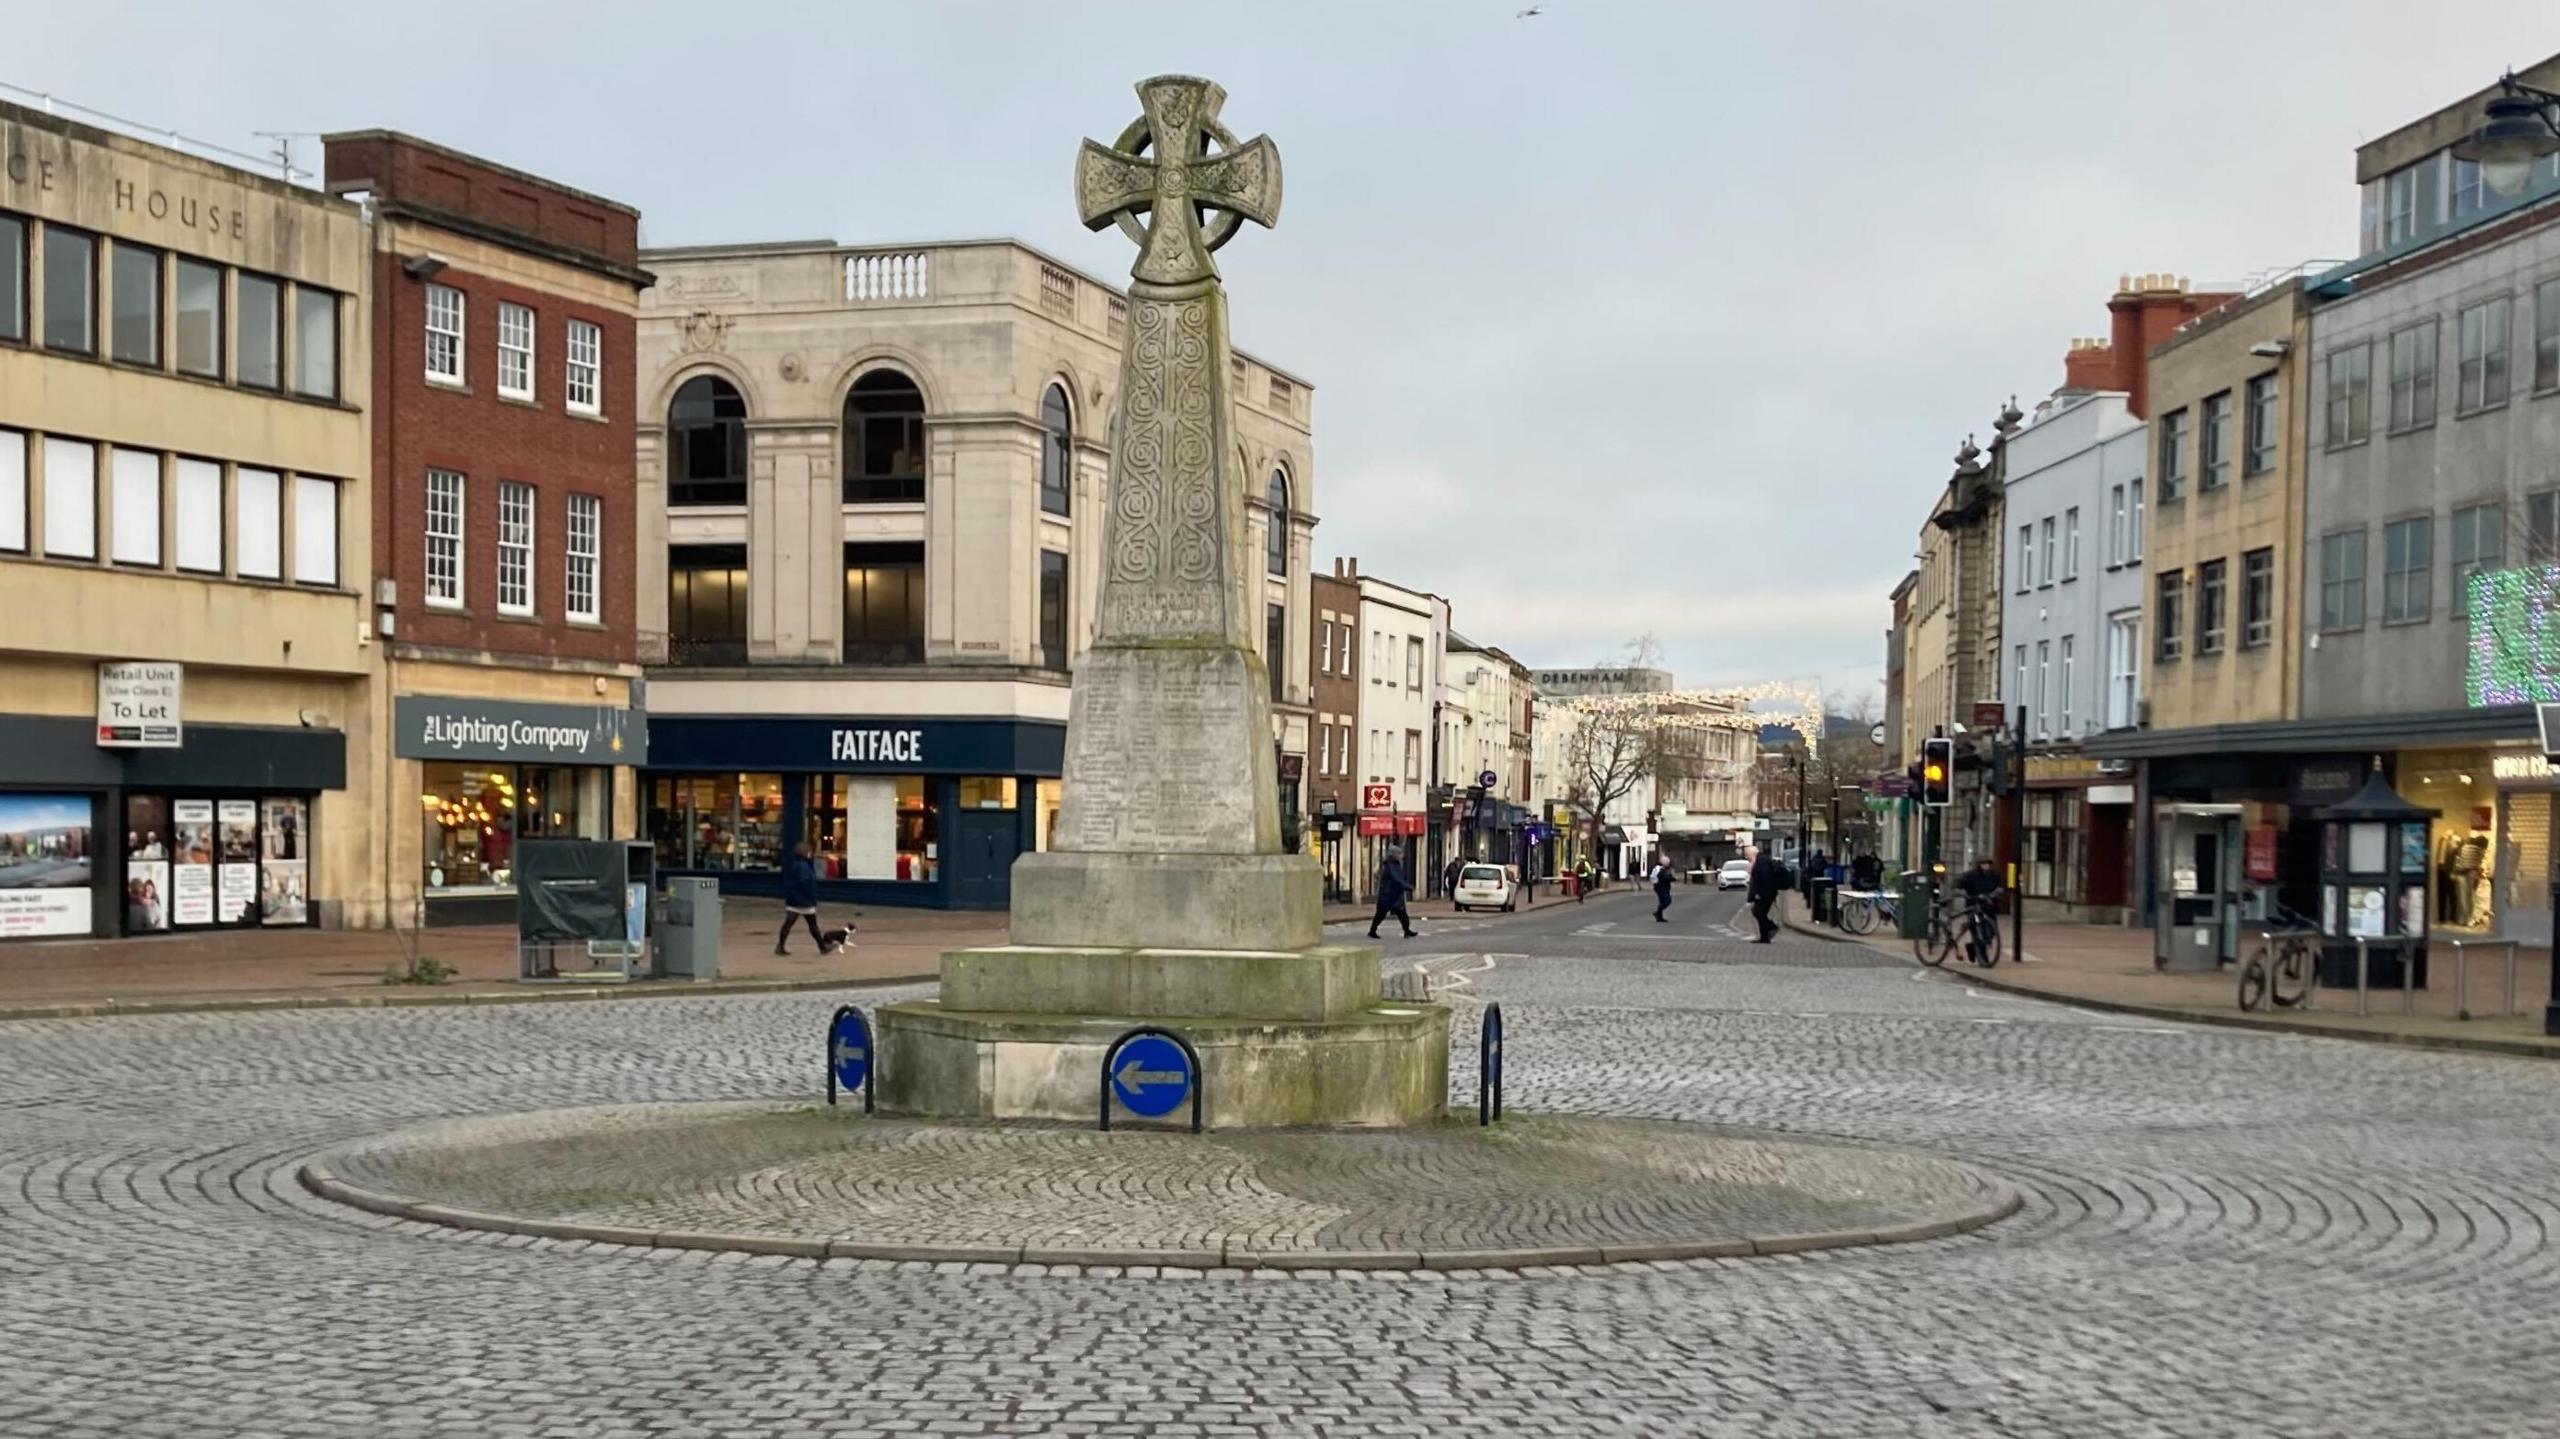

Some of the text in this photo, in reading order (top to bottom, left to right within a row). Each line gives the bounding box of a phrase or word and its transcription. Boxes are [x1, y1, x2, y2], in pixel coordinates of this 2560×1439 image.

[114, 178, 243, 240] HOUSE
[103, 667, 175, 681] Retail Unit
[1541, 671, 1628, 684] DEBENHAM
[111, 702, 167, 719] To Let
[424, 714, 589, 754] The Lighting Company
[831, 729, 922, 762] FATFACE
